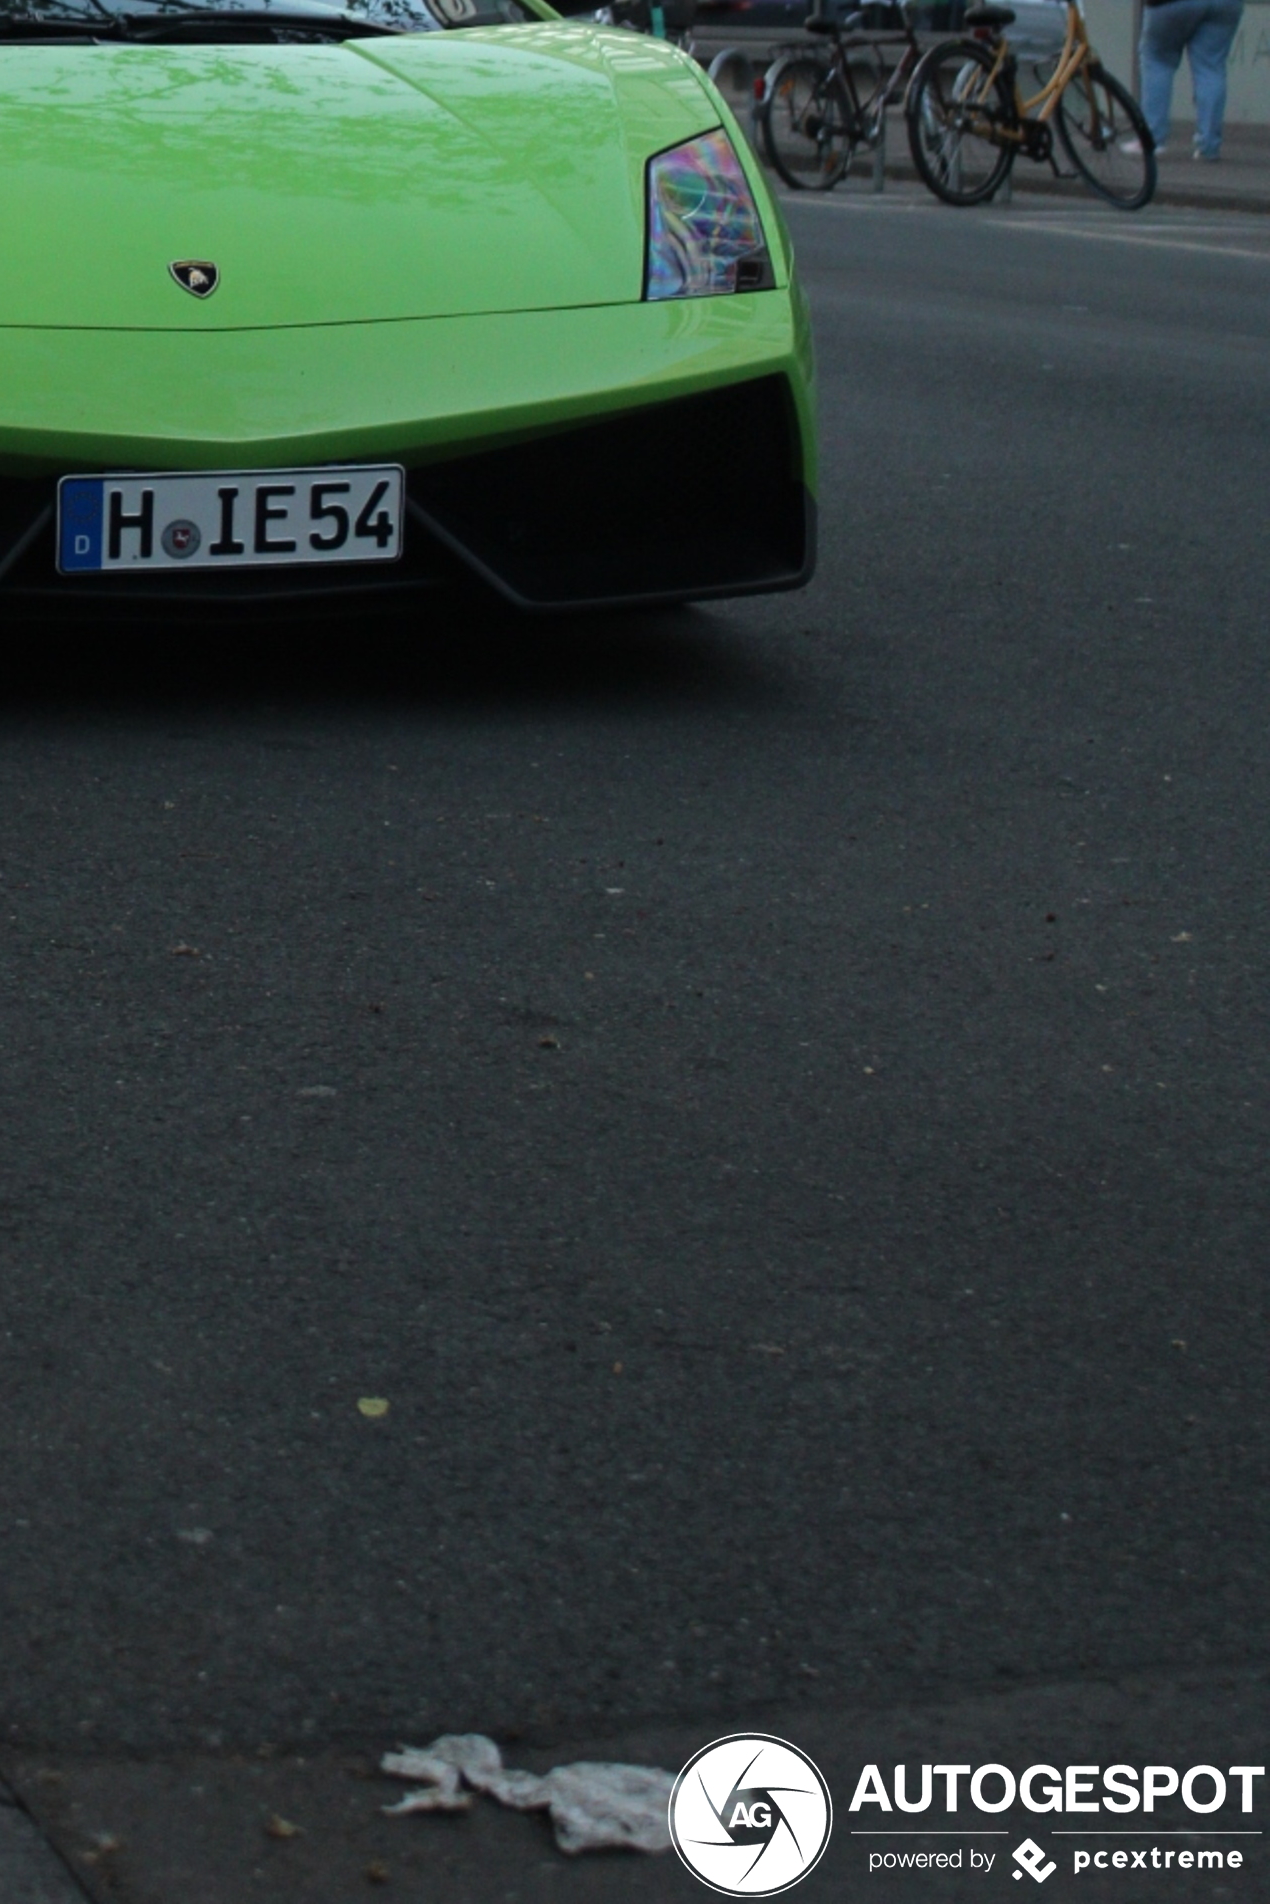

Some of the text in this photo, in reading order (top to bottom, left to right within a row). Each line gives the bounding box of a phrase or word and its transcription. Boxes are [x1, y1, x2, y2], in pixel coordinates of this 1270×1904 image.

[74, 479, 395, 560] D H IE54
